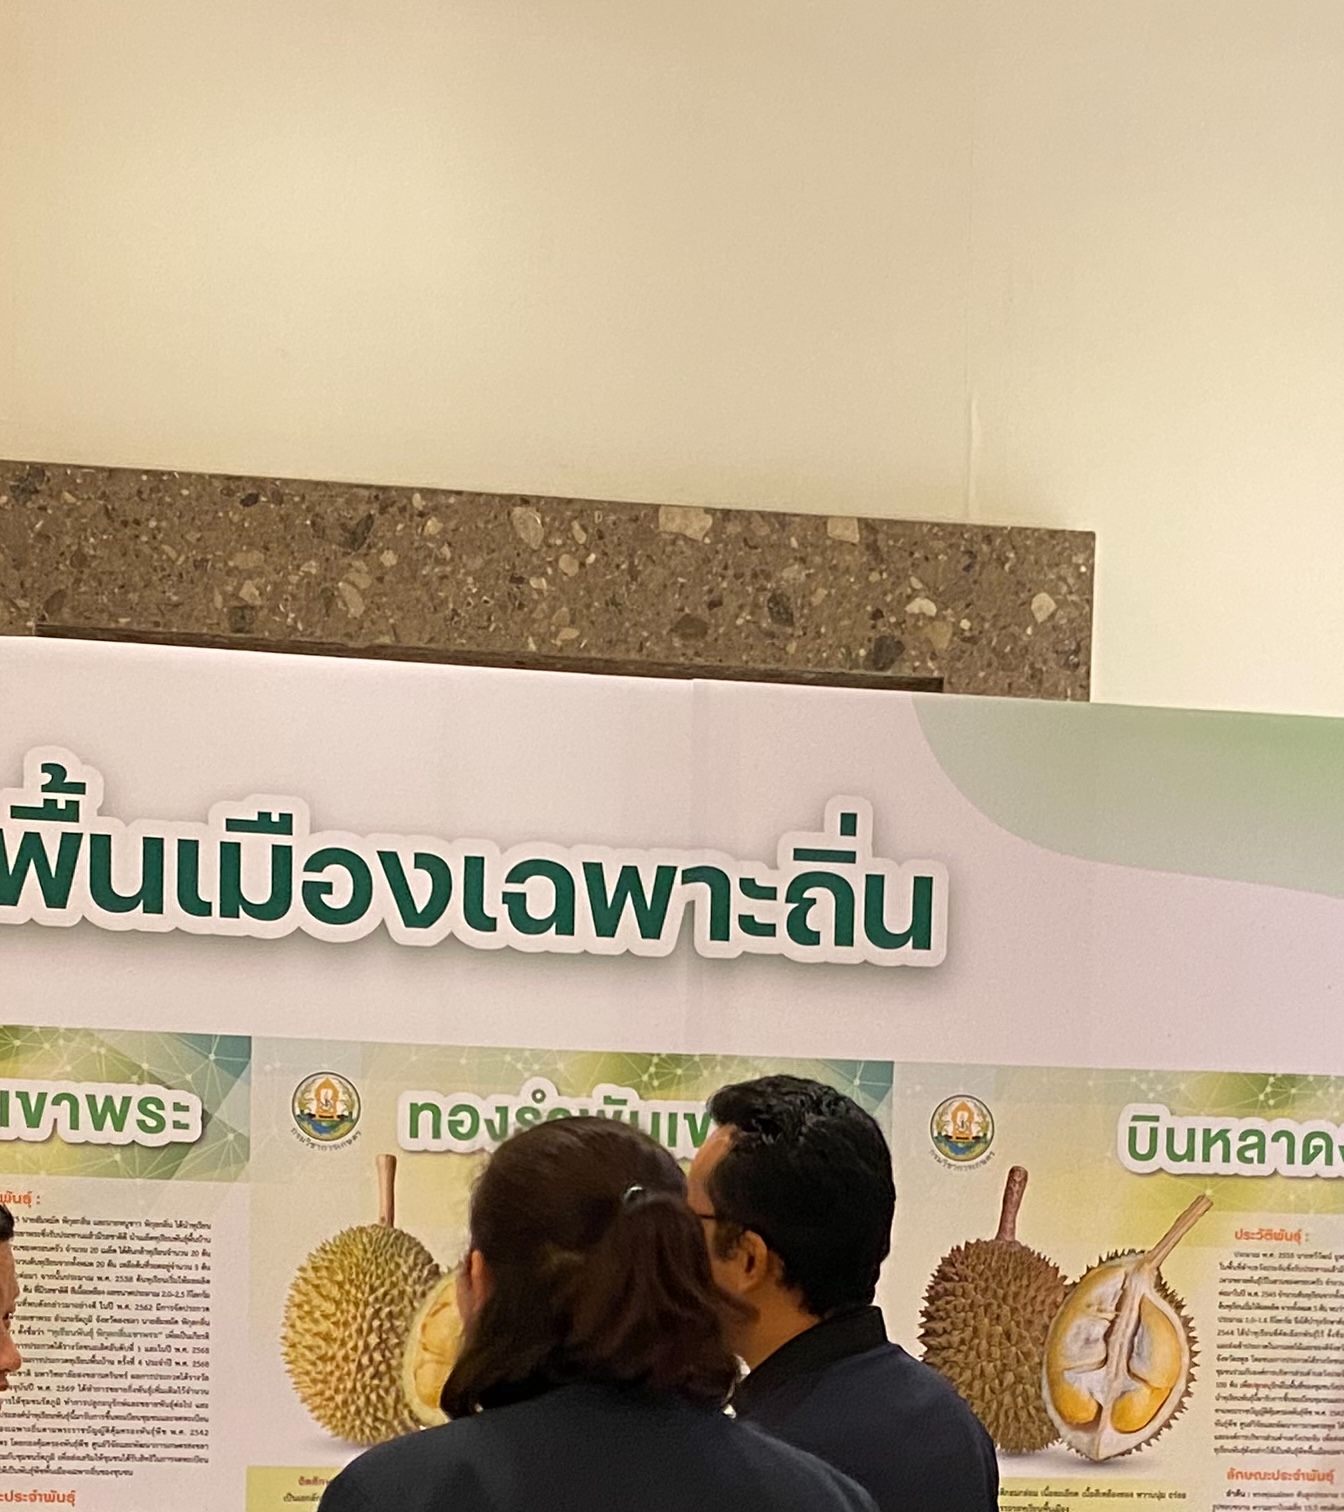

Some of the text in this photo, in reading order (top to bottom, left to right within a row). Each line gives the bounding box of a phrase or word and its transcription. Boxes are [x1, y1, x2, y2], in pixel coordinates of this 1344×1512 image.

[1226, 1468, 1335, 1485] ลักษณะประจำพันธุ์
